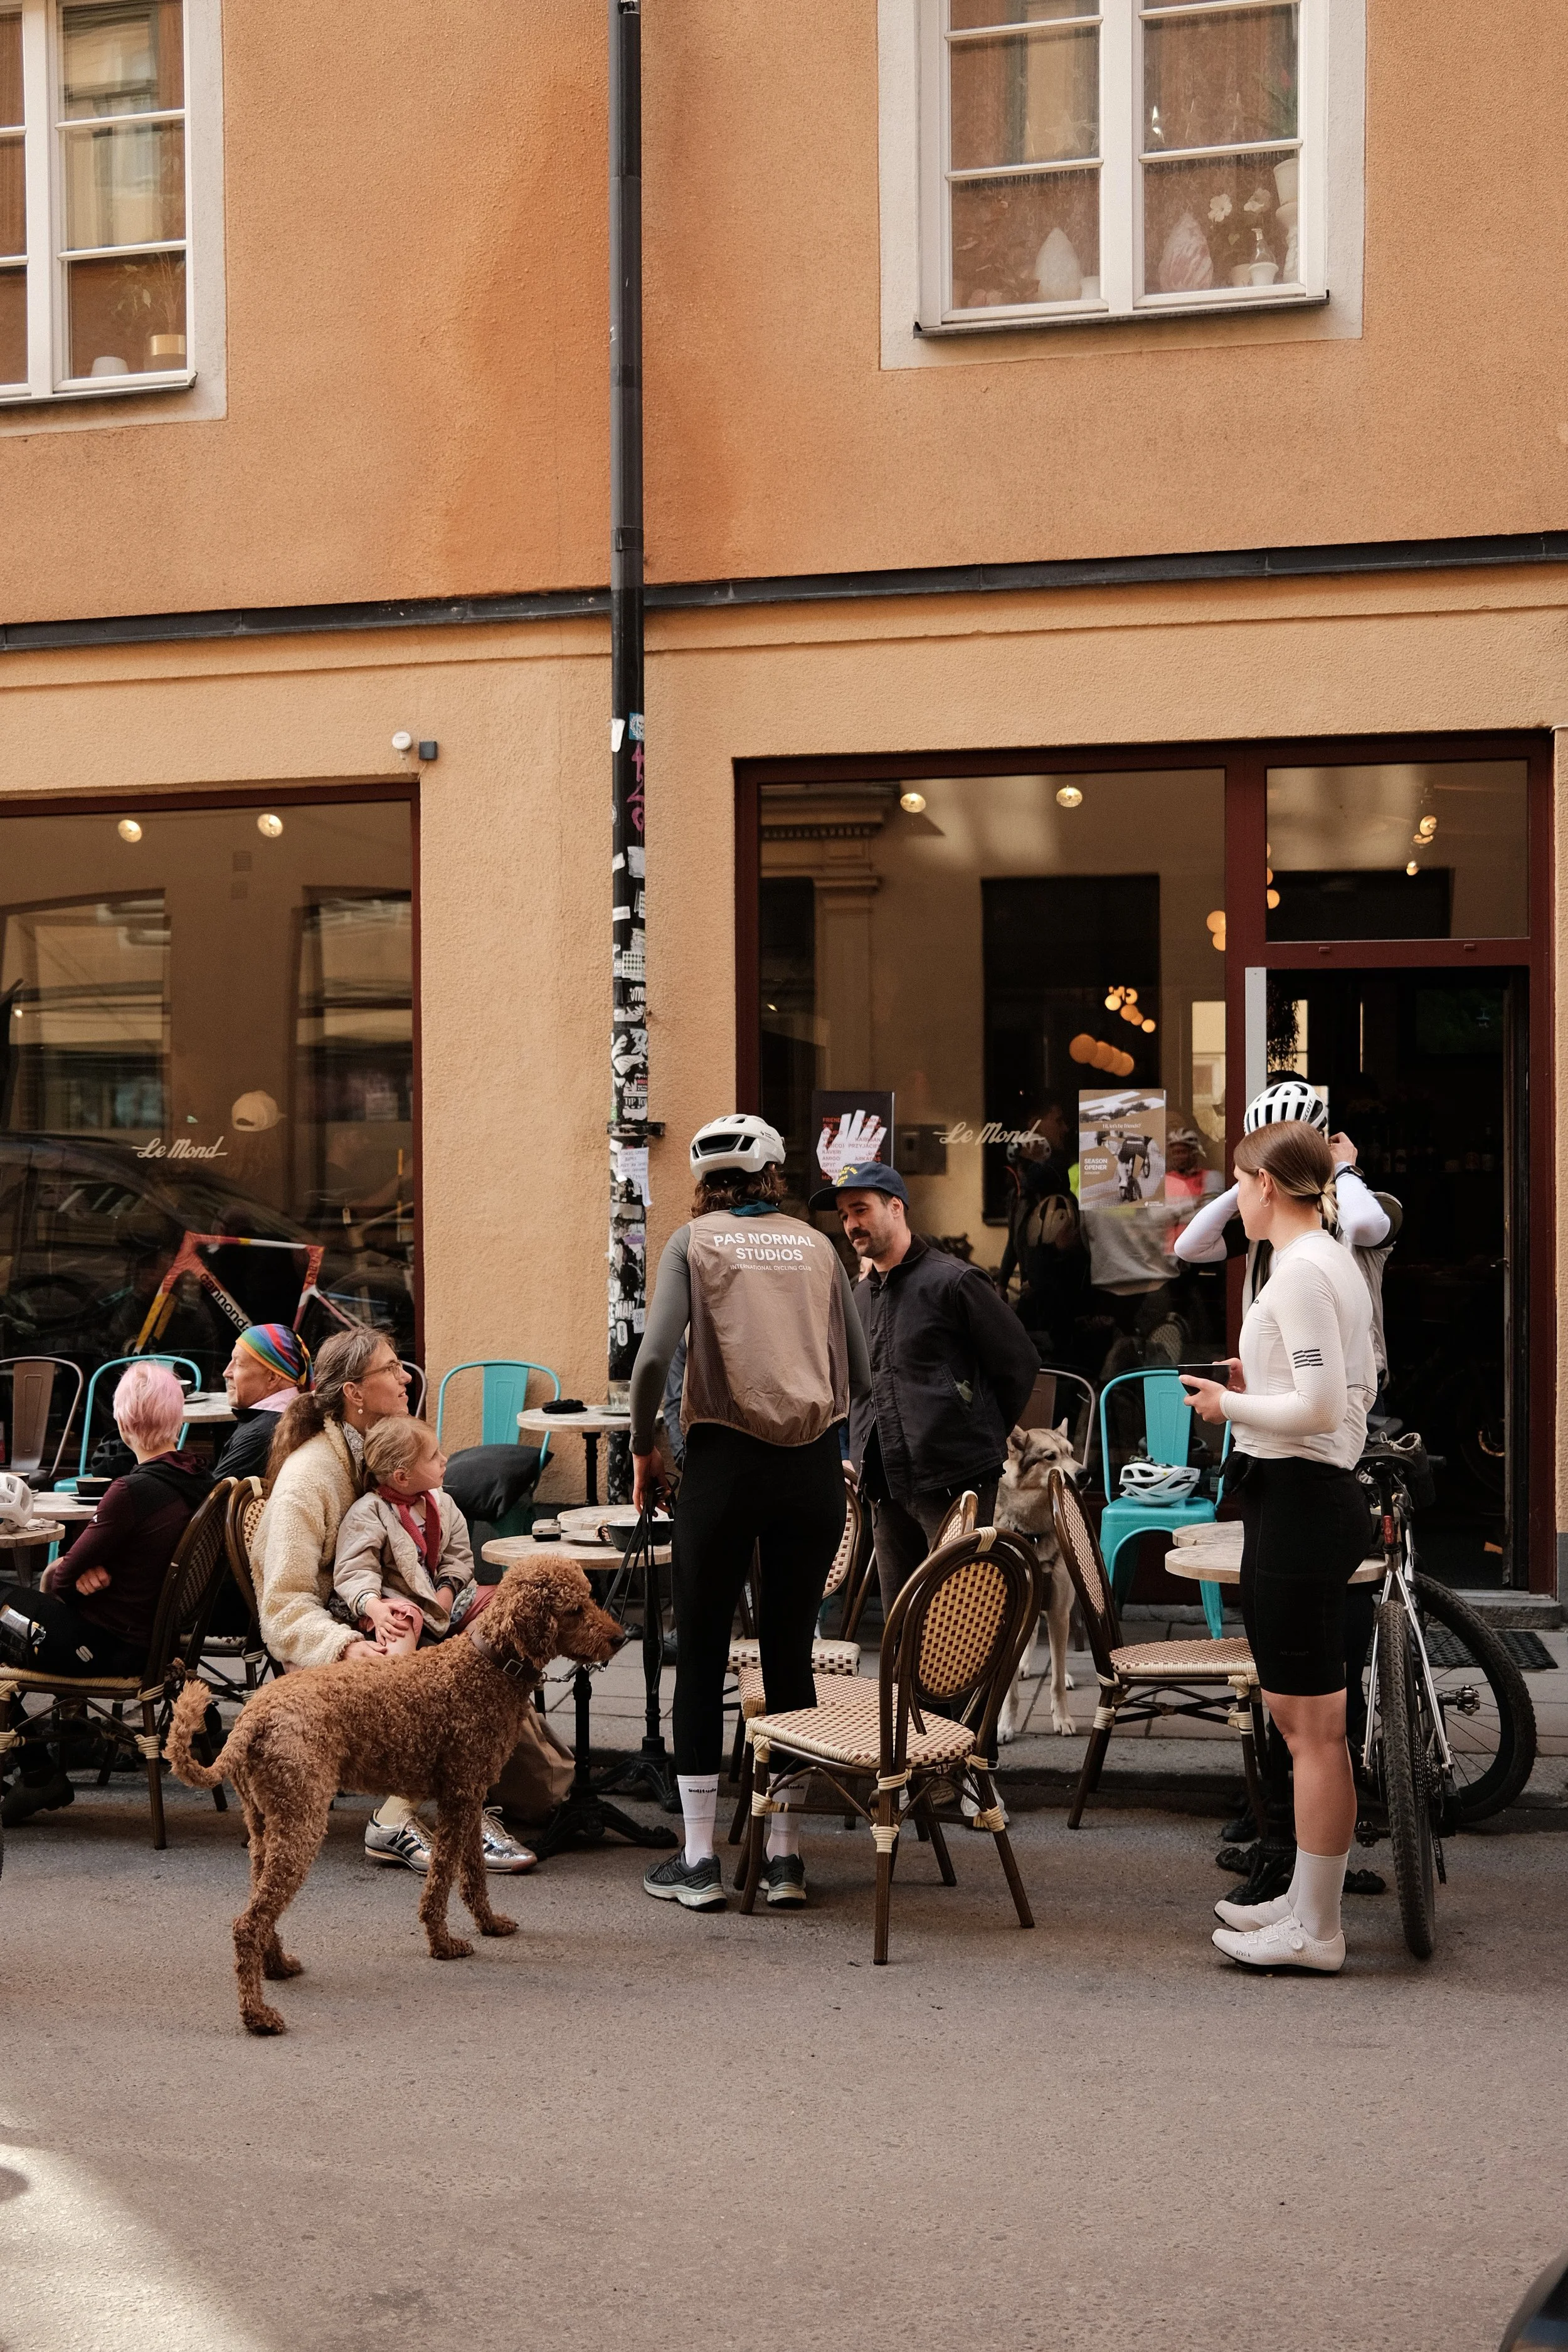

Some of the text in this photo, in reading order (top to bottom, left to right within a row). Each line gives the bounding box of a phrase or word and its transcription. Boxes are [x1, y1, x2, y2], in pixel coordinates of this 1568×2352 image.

[1302, 1099, 1313, 1121] SCOTT
[933, 1119, 1046, 1146] Le Mond
[131, 1135, 228, 1158] Le Mond
[713, 1232, 815, 1248] PAS NORMAL
[735, 1247, 803, 1261] STUDIOS
[684, 1869, 713, 1884] SALOMON
